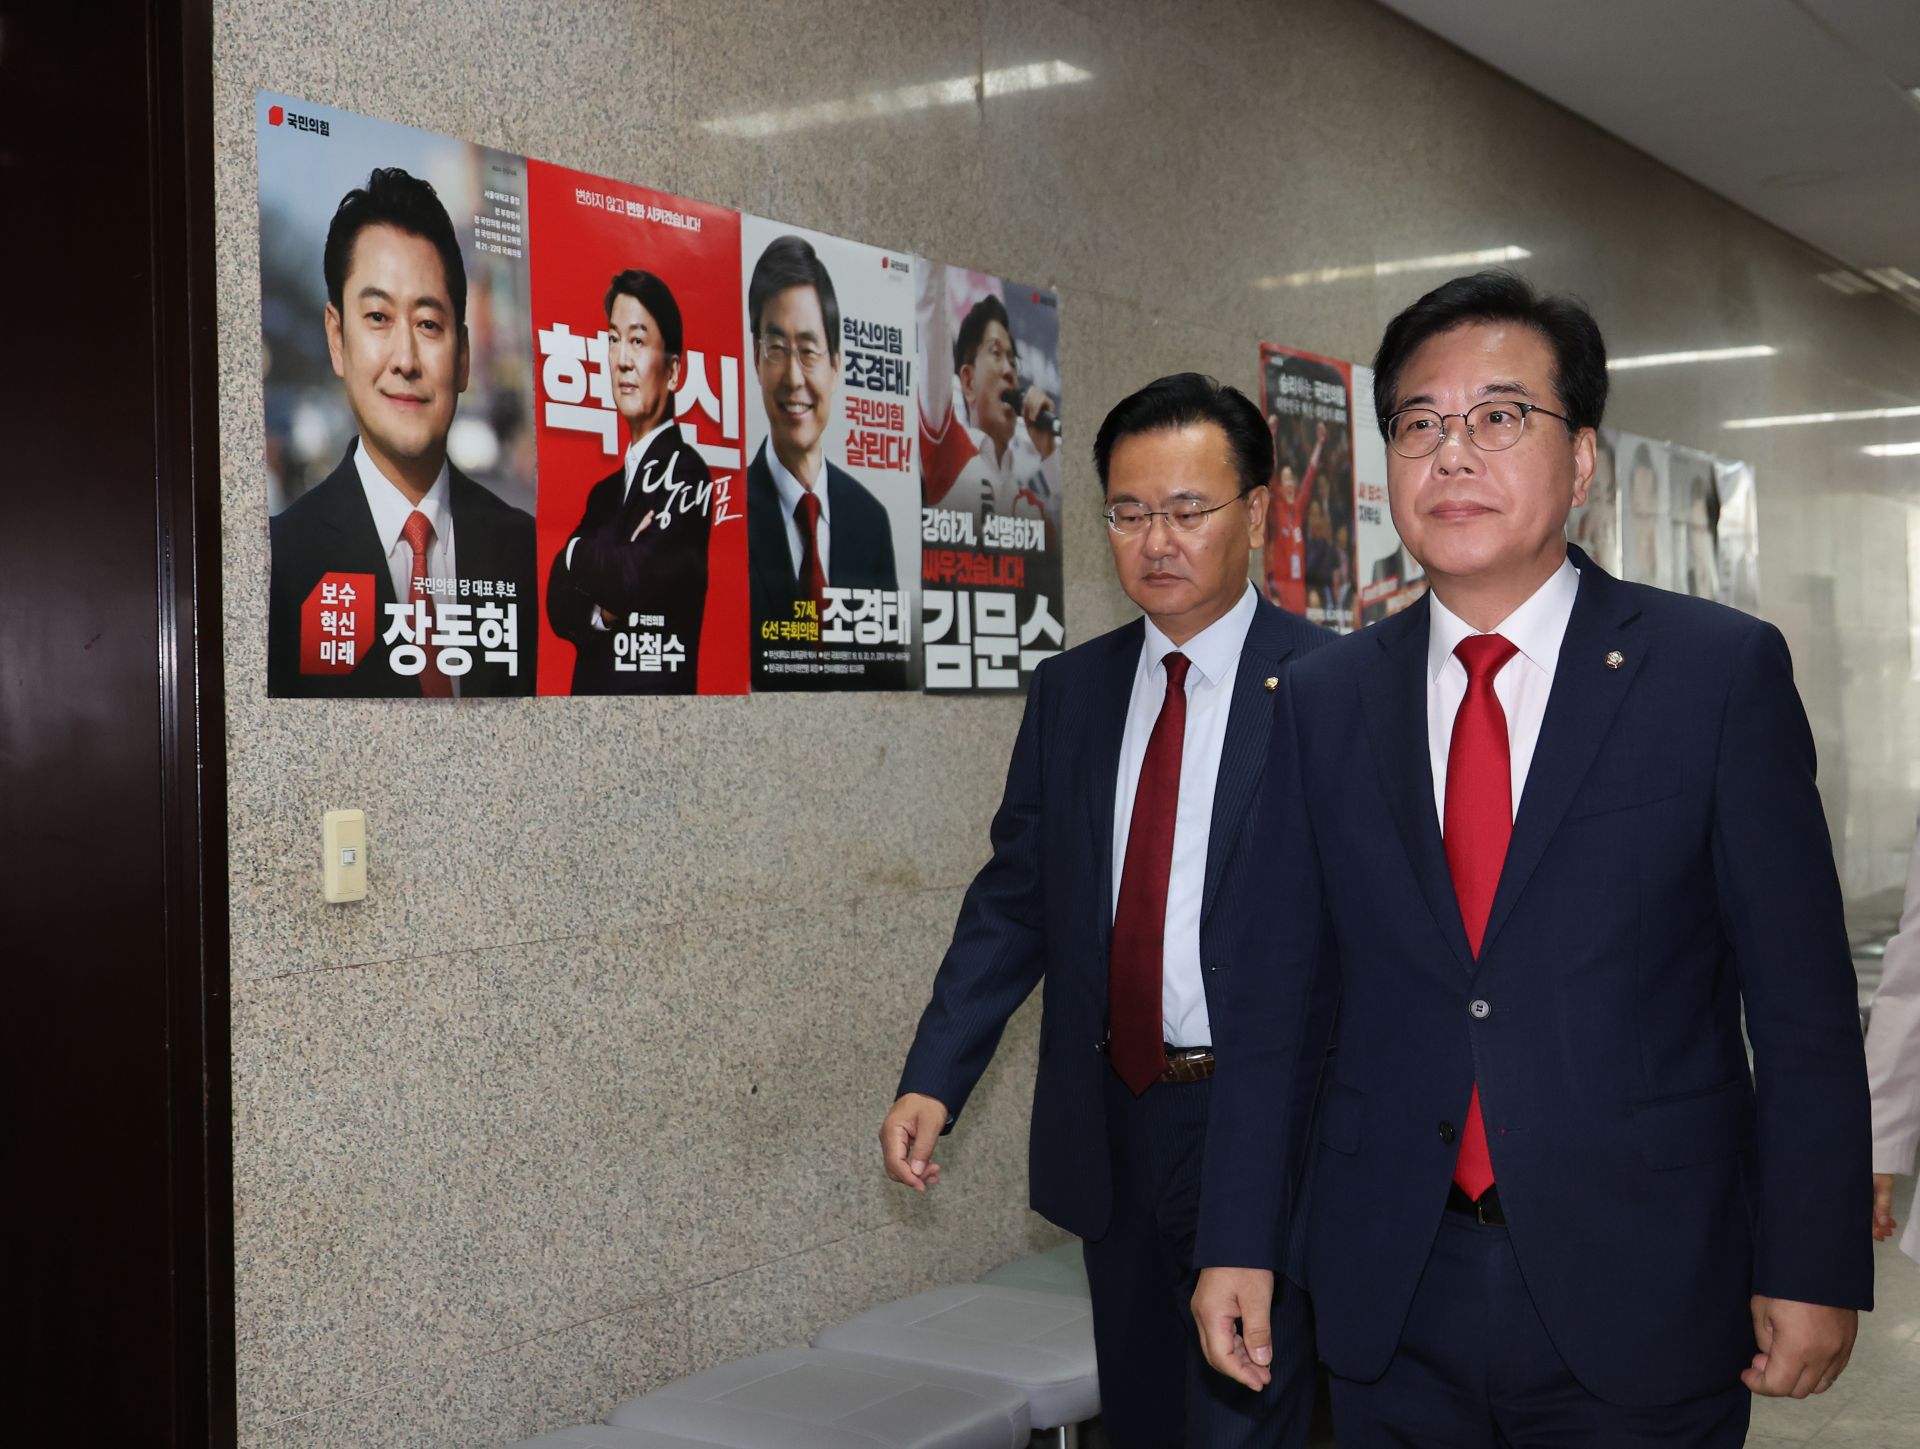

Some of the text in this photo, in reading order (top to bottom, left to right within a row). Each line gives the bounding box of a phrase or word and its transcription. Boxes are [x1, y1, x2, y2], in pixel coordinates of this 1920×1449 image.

[286, 112, 330, 137] 국민의힘
[484, 189, 510, 203] 서울대학교
[480, 216, 501, 229] 국민의힘
[576, 188, 702, 232] 변하지 않고 변화 시키겠습니다!
[481, 229, 501, 242] 국민의힘
[501, 246, 522, 258] 국회의원
[843, 316, 903, 355] 혁신의힘
[845, 350, 911, 396] 조경태!
[845, 395, 904, 431] 국민의힘
[846, 429, 912, 473] 살린다!
[922, 508, 1046, 552] 강하게, 선명하게
[922, 550, 1025, 588] 싸우겠습니다!
[320, 582, 357, 608] 보수
[413, 577, 517, 598] 국민의힘 당 대표 후보
[320, 610, 356, 637] 혁신
[793, 600, 819, 620] 57세,
[822, 587, 912, 645] 조경태
[382, 599, 518, 677] 장동혁
[761, 620, 819, 641] 6선 국회의원
[320, 640, 356, 666] 미래
[613, 632, 686, 672] 안철수
